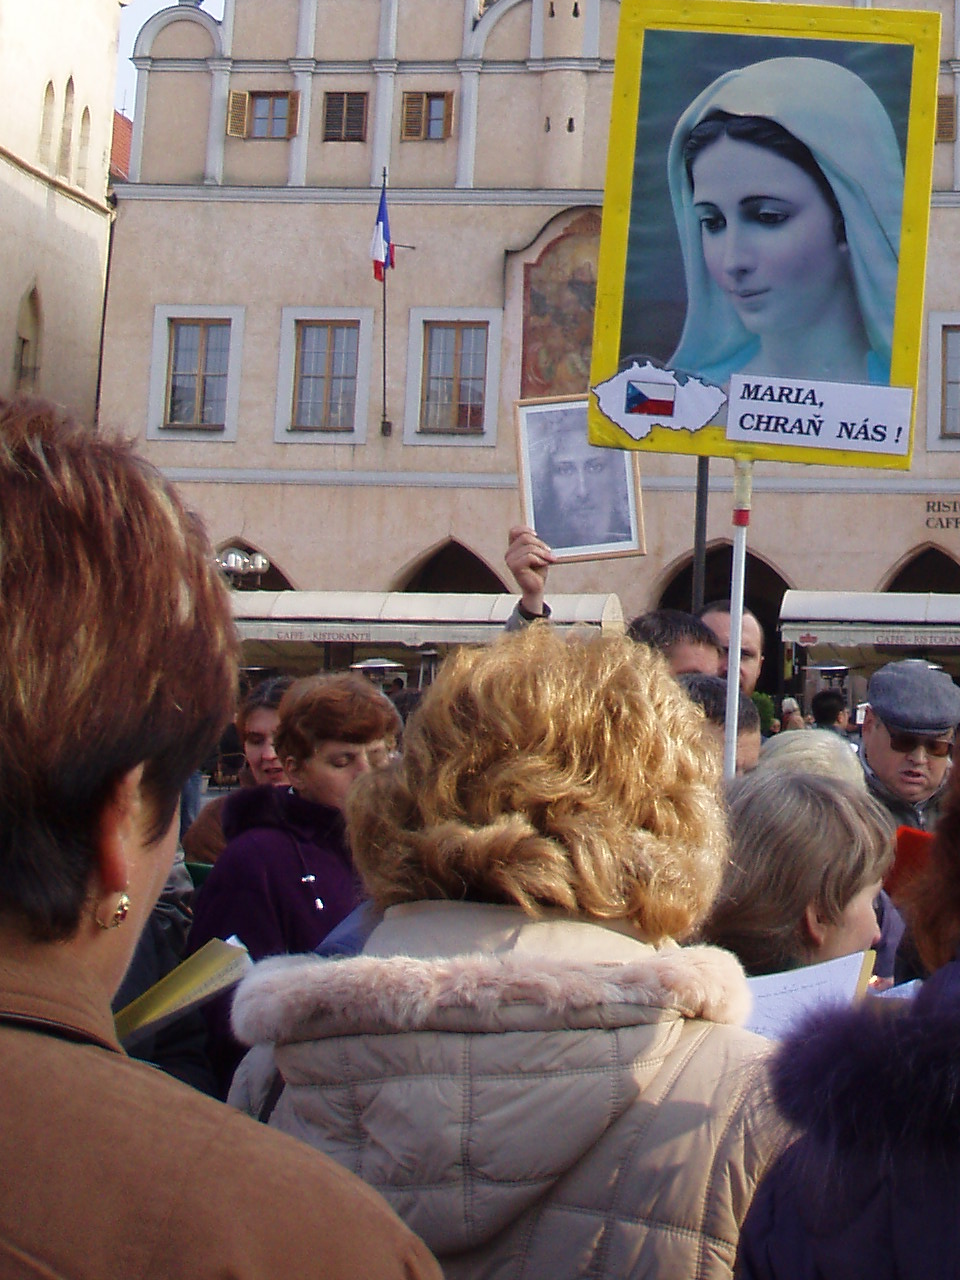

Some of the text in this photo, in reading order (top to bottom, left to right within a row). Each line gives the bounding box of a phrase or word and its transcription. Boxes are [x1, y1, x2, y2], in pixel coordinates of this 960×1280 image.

[740, 383, 824, 408] MARIA,
[739, 413, 824, 437] CHRAŇ
[312, 631, 371, 641] RISTORANTE
